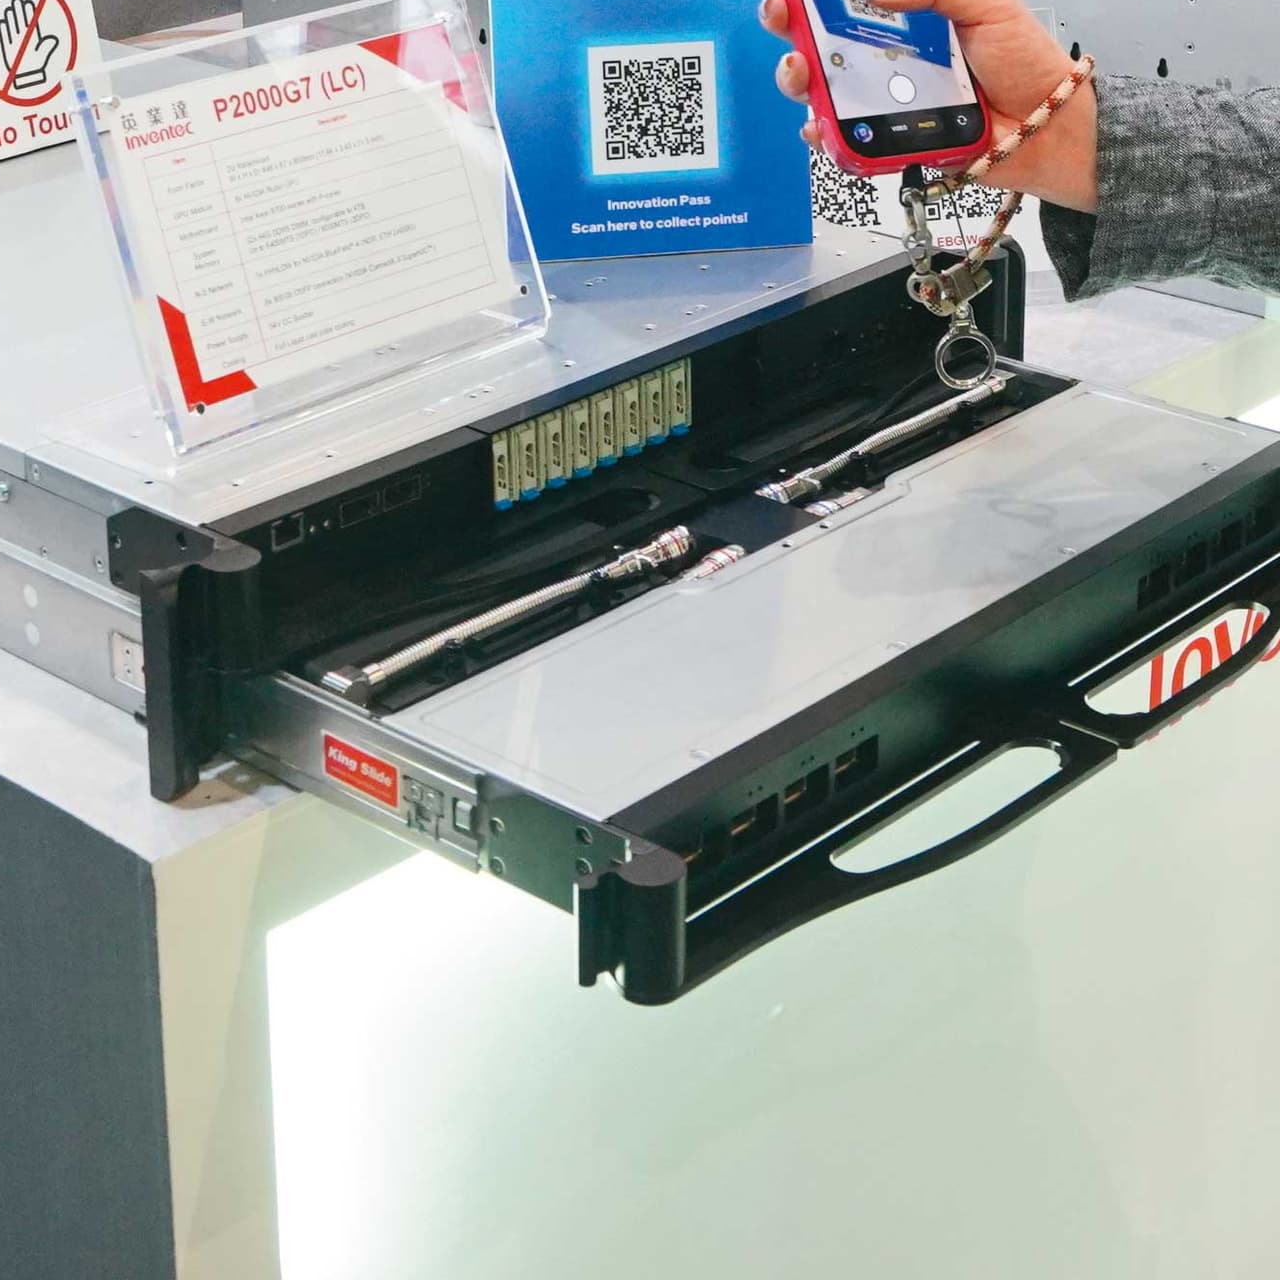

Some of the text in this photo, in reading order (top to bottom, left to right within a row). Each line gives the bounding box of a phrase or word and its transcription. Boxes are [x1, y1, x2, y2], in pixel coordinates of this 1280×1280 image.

[213, 63, 367, 122] P2000G7 (LC)
[22, 104, 100, 138] Tou
[124, 121, 195, 151] Inventec
[607, 194, 711, 211] Innovation Pass
[571, 212, 748, 234] Scan here to collect points!
[936, 233, 986, 248] EBG W
[328, 745, 358, 772] King
[360, 761, 393, 788] Slide
